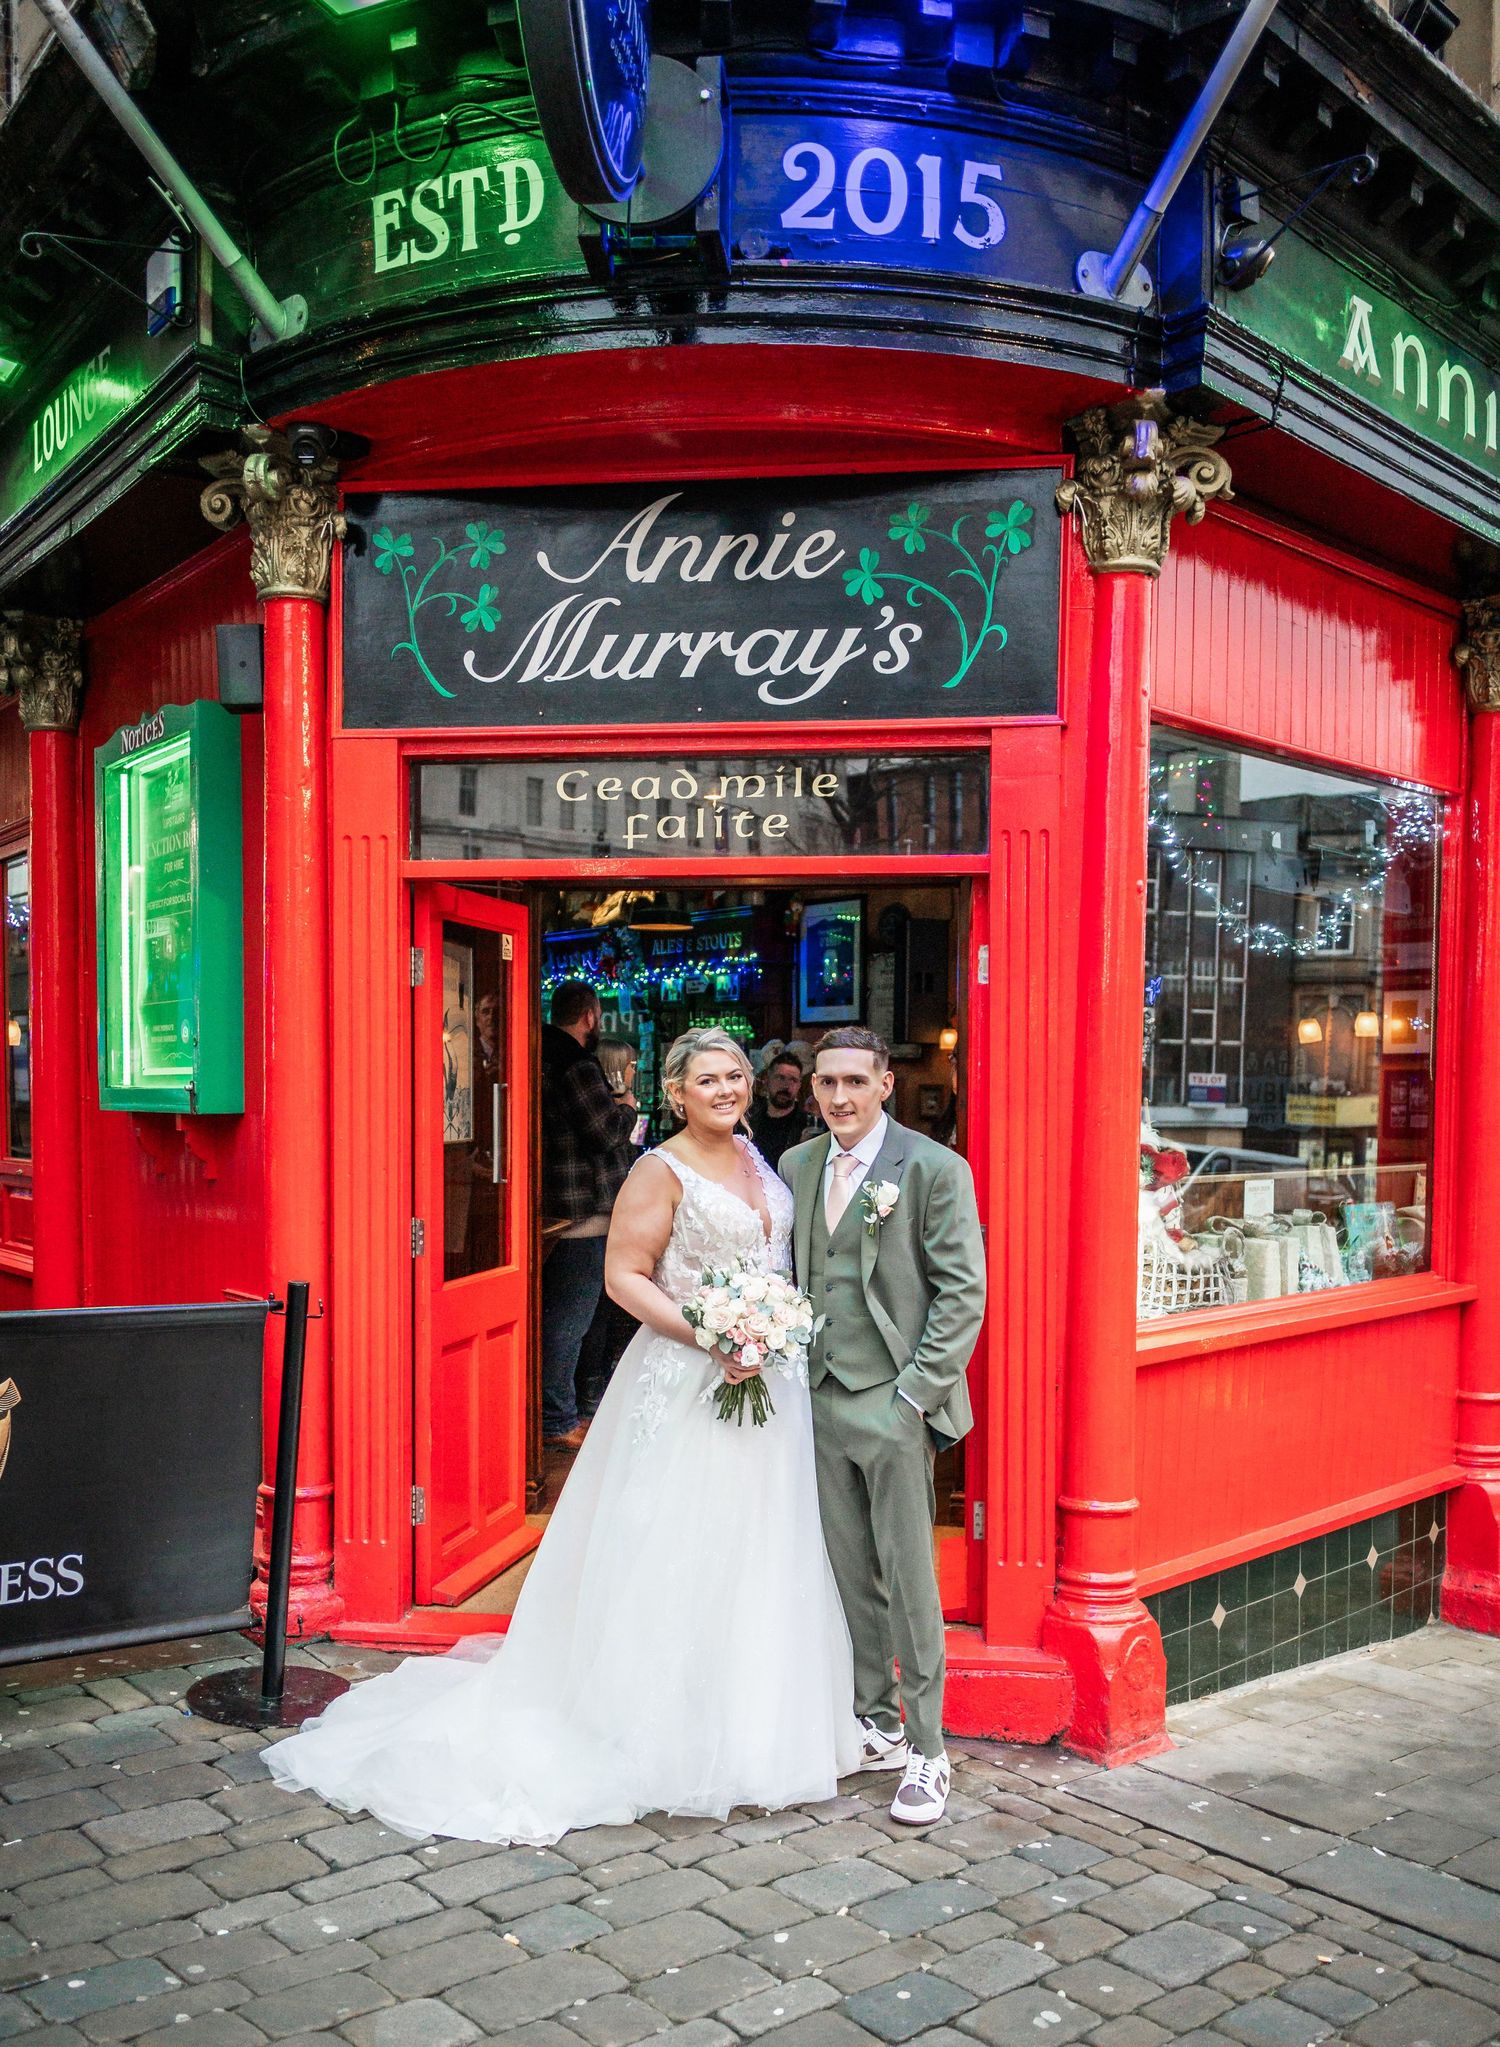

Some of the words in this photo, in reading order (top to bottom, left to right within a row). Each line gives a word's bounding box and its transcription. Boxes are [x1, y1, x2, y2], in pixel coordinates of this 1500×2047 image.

[370, 157, 545, 274] ESTD
[780, 141, 1006, 250] 2015
[33, 344, 111, 475] LOUNGE
[535, 490, 846, 585] Annie
[462, 592, 924, 706] Murray's
[120, 710, 165, 755] NOTICES
[555, 768, 699, 802] Cead
[150, 833, 181, 857] NCTION
[652, 938, 683, 956] ALES
[696, 931, 743, 953] STOUTS
[0, 1554, 85, 1606] ESS
